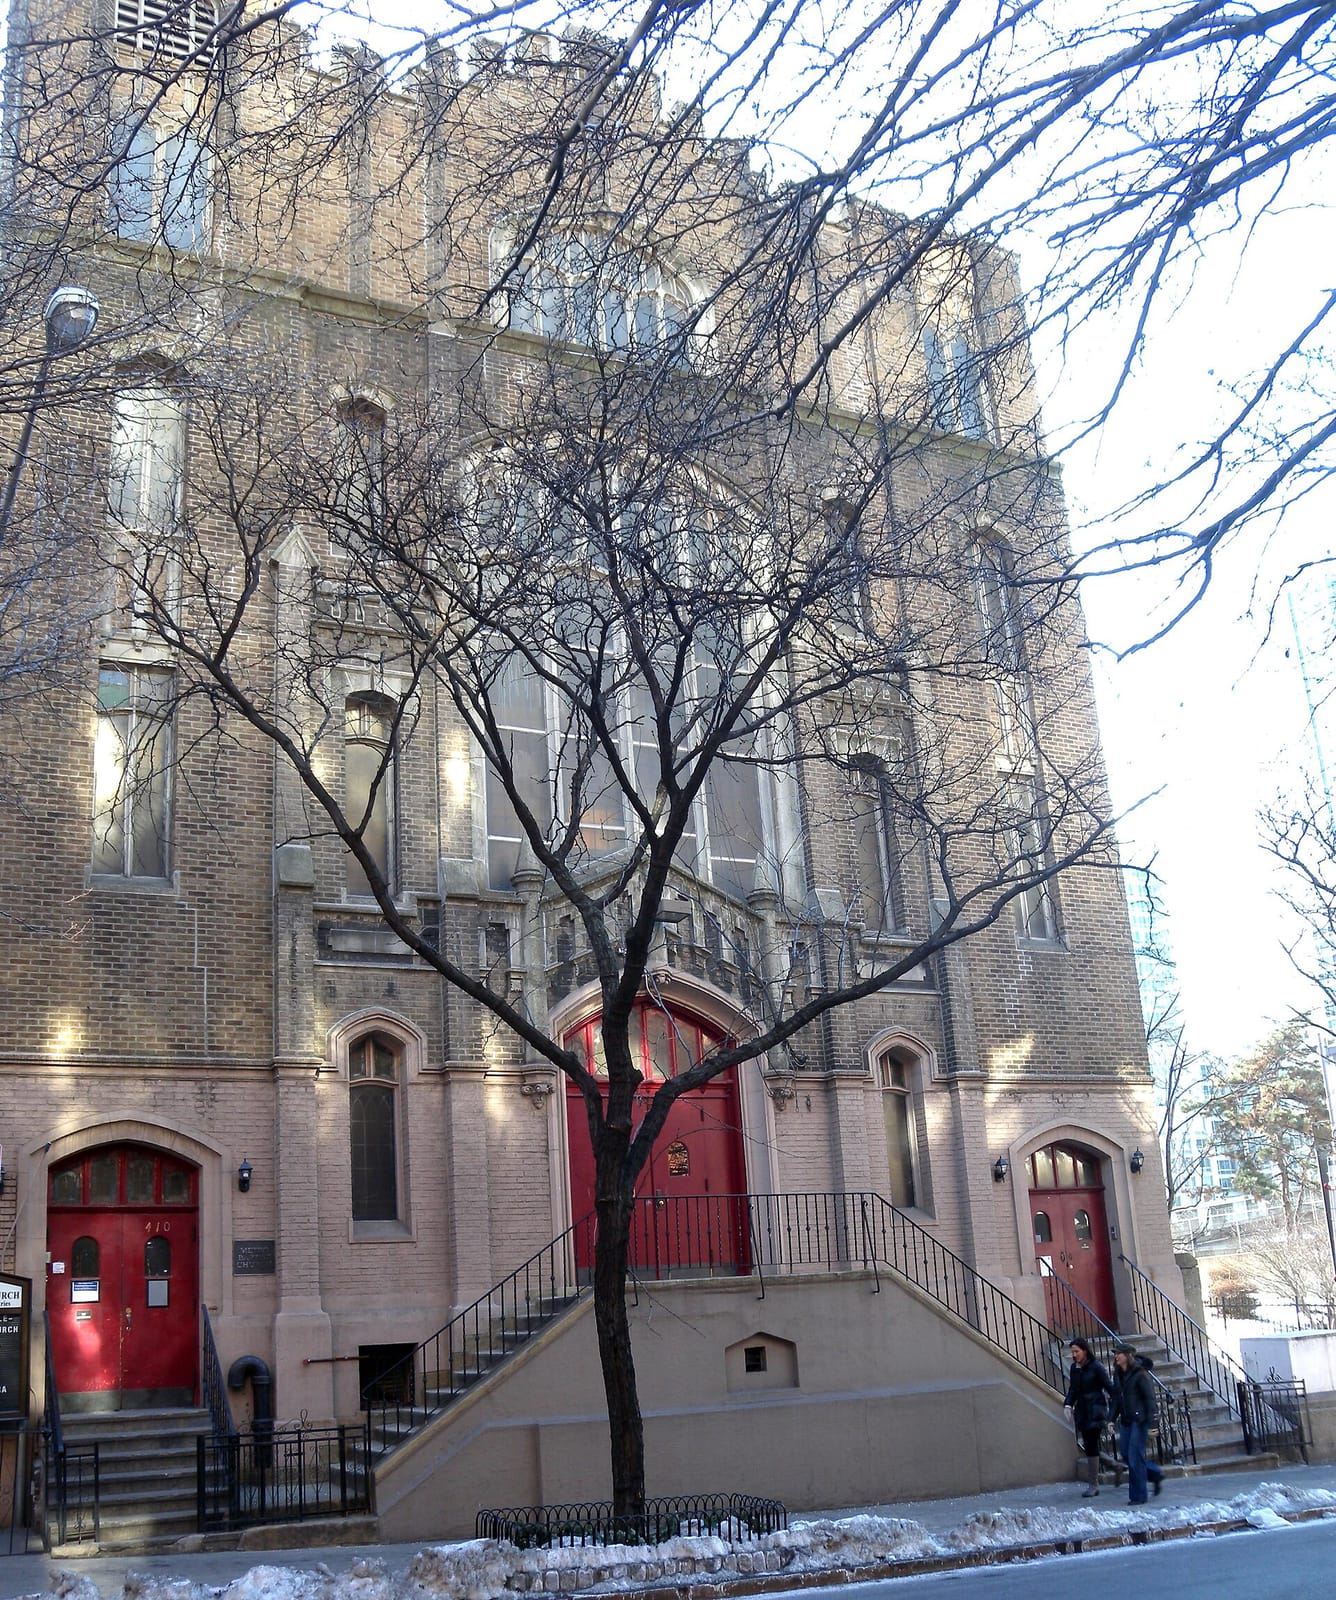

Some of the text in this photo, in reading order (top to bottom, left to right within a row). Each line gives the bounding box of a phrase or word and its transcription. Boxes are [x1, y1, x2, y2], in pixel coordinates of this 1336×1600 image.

[145, 1220, 171, 1233] 410
[0, 1291, 19, 1299] RCH
[0, 1325, 19, 1333] RCH
